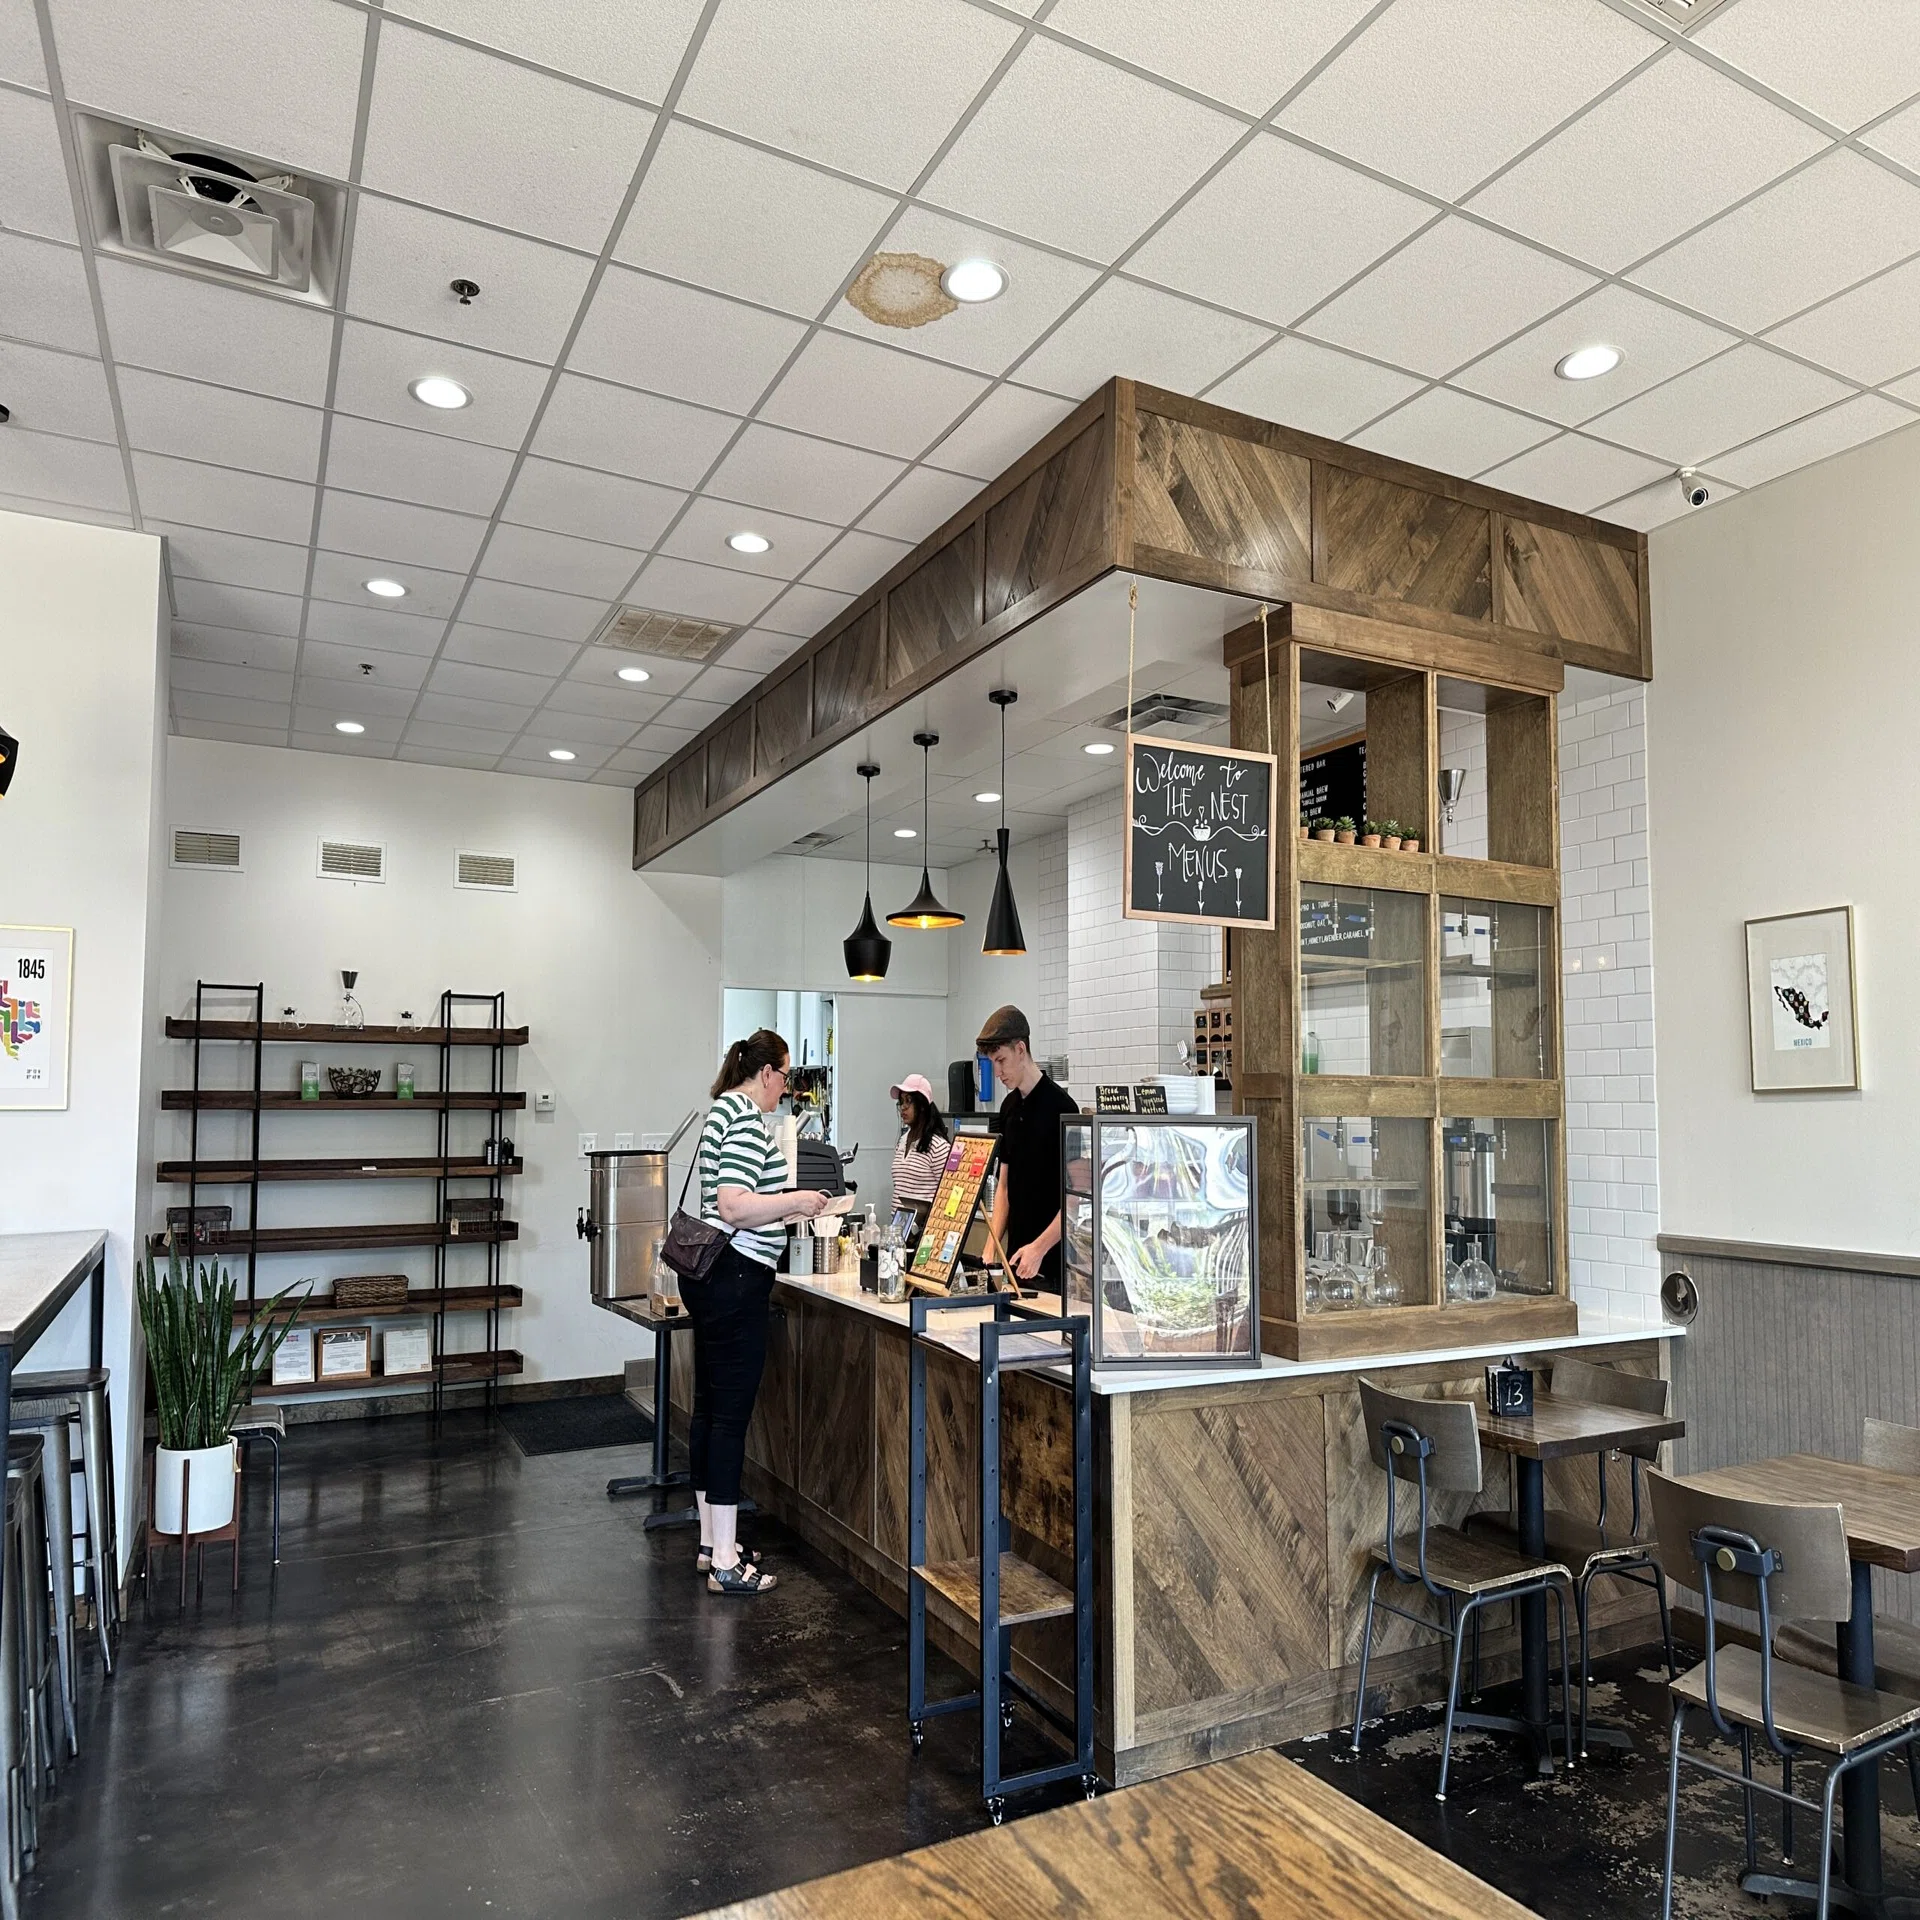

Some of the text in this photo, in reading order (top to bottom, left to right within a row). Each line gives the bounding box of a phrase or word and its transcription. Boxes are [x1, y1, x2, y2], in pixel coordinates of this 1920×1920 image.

[1135, 751, 1248, 793] Welcome to
[1316, 760, 1326, 769] BAR
[1162, 780, 1249, 825] THE NEST
[1301, 785, 1328, 799] ANUAL BREW
[1168, 842, 1229, 883] MENUS
[17, 958, 45, 980] 1845
[1793, 1038, 1812, 1047] MEXICO
[1135, 1086, 1157, 1096] Lemon
[1505, 1381, 1524, 1406] 13
